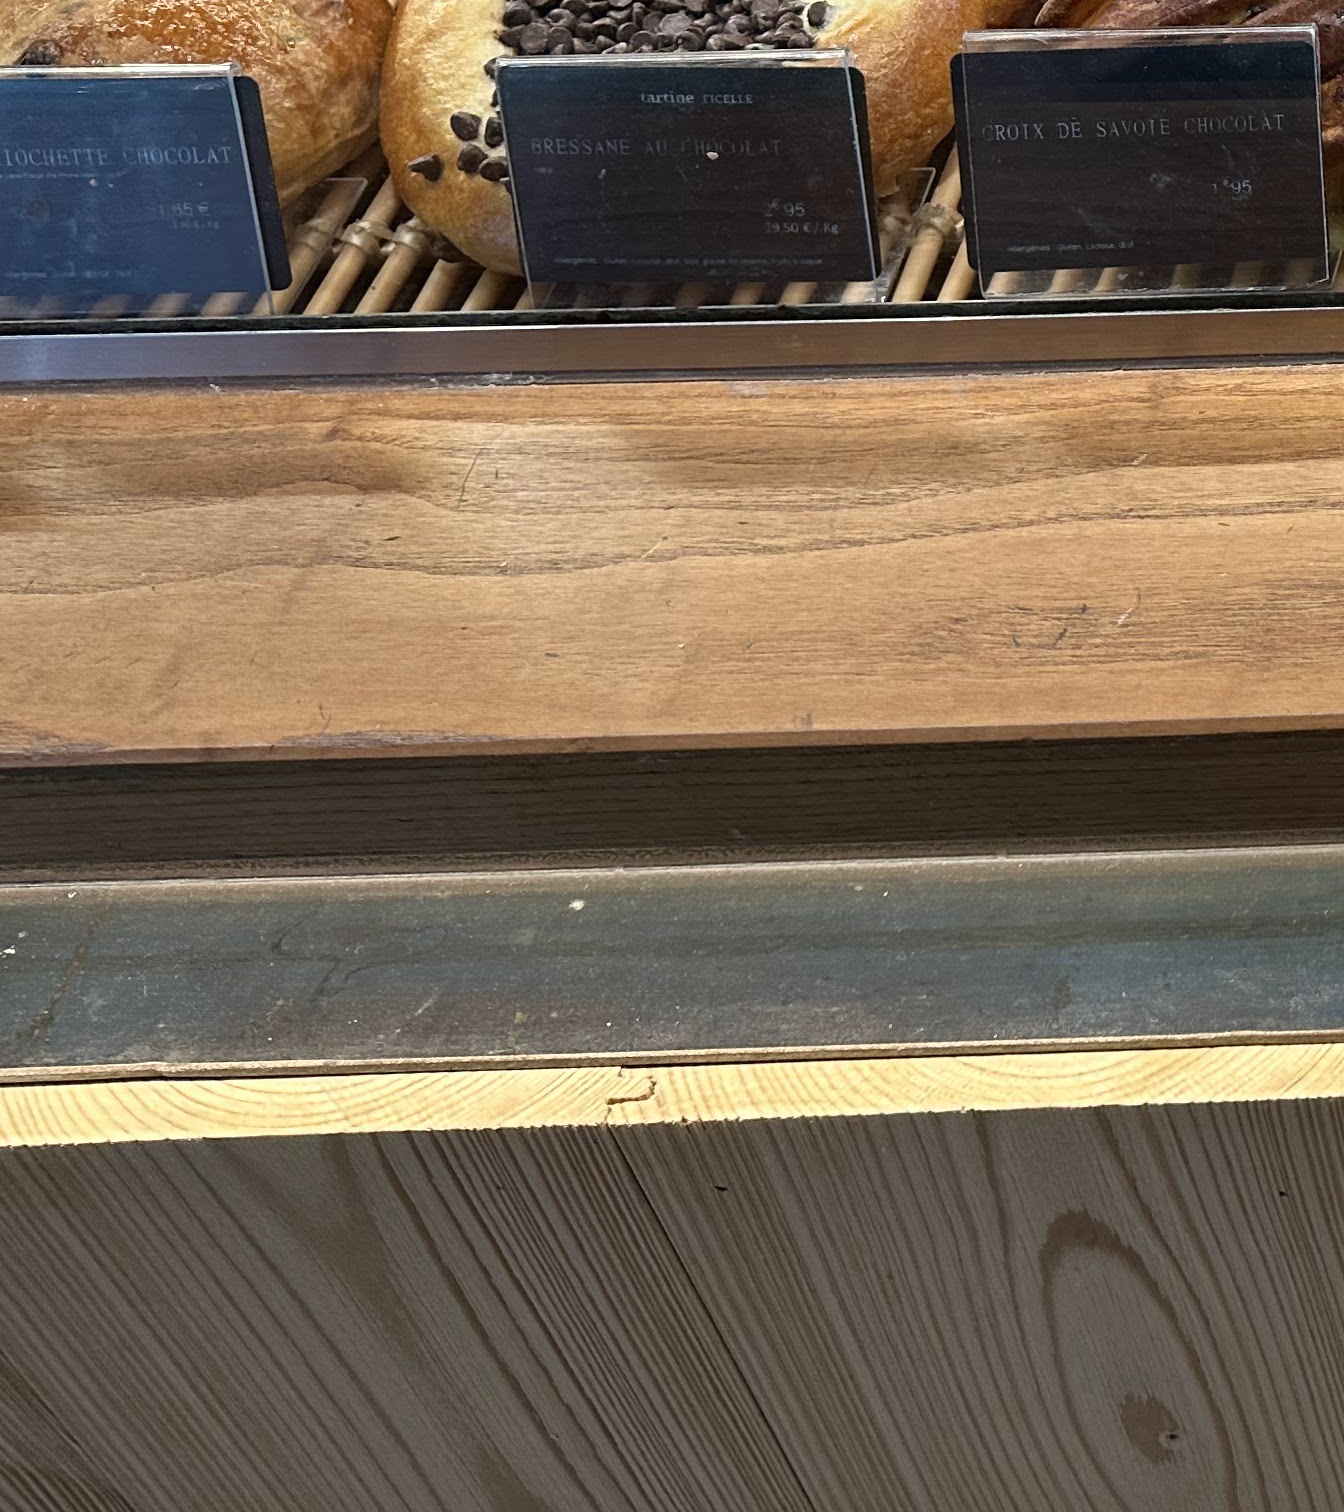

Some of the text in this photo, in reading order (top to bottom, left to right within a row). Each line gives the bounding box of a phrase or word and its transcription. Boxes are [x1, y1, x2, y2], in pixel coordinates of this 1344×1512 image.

[640, 89, 754, 105] tartine FICELLE
[981, 113, 1285, 142] CROIX DE SAVOIE CHOCOLAT
[0, 145, 233, 167] IOCHETTE CHOCOLAT
[530, 138, 783, 157] BRESSANE AU CHOCOLAT
